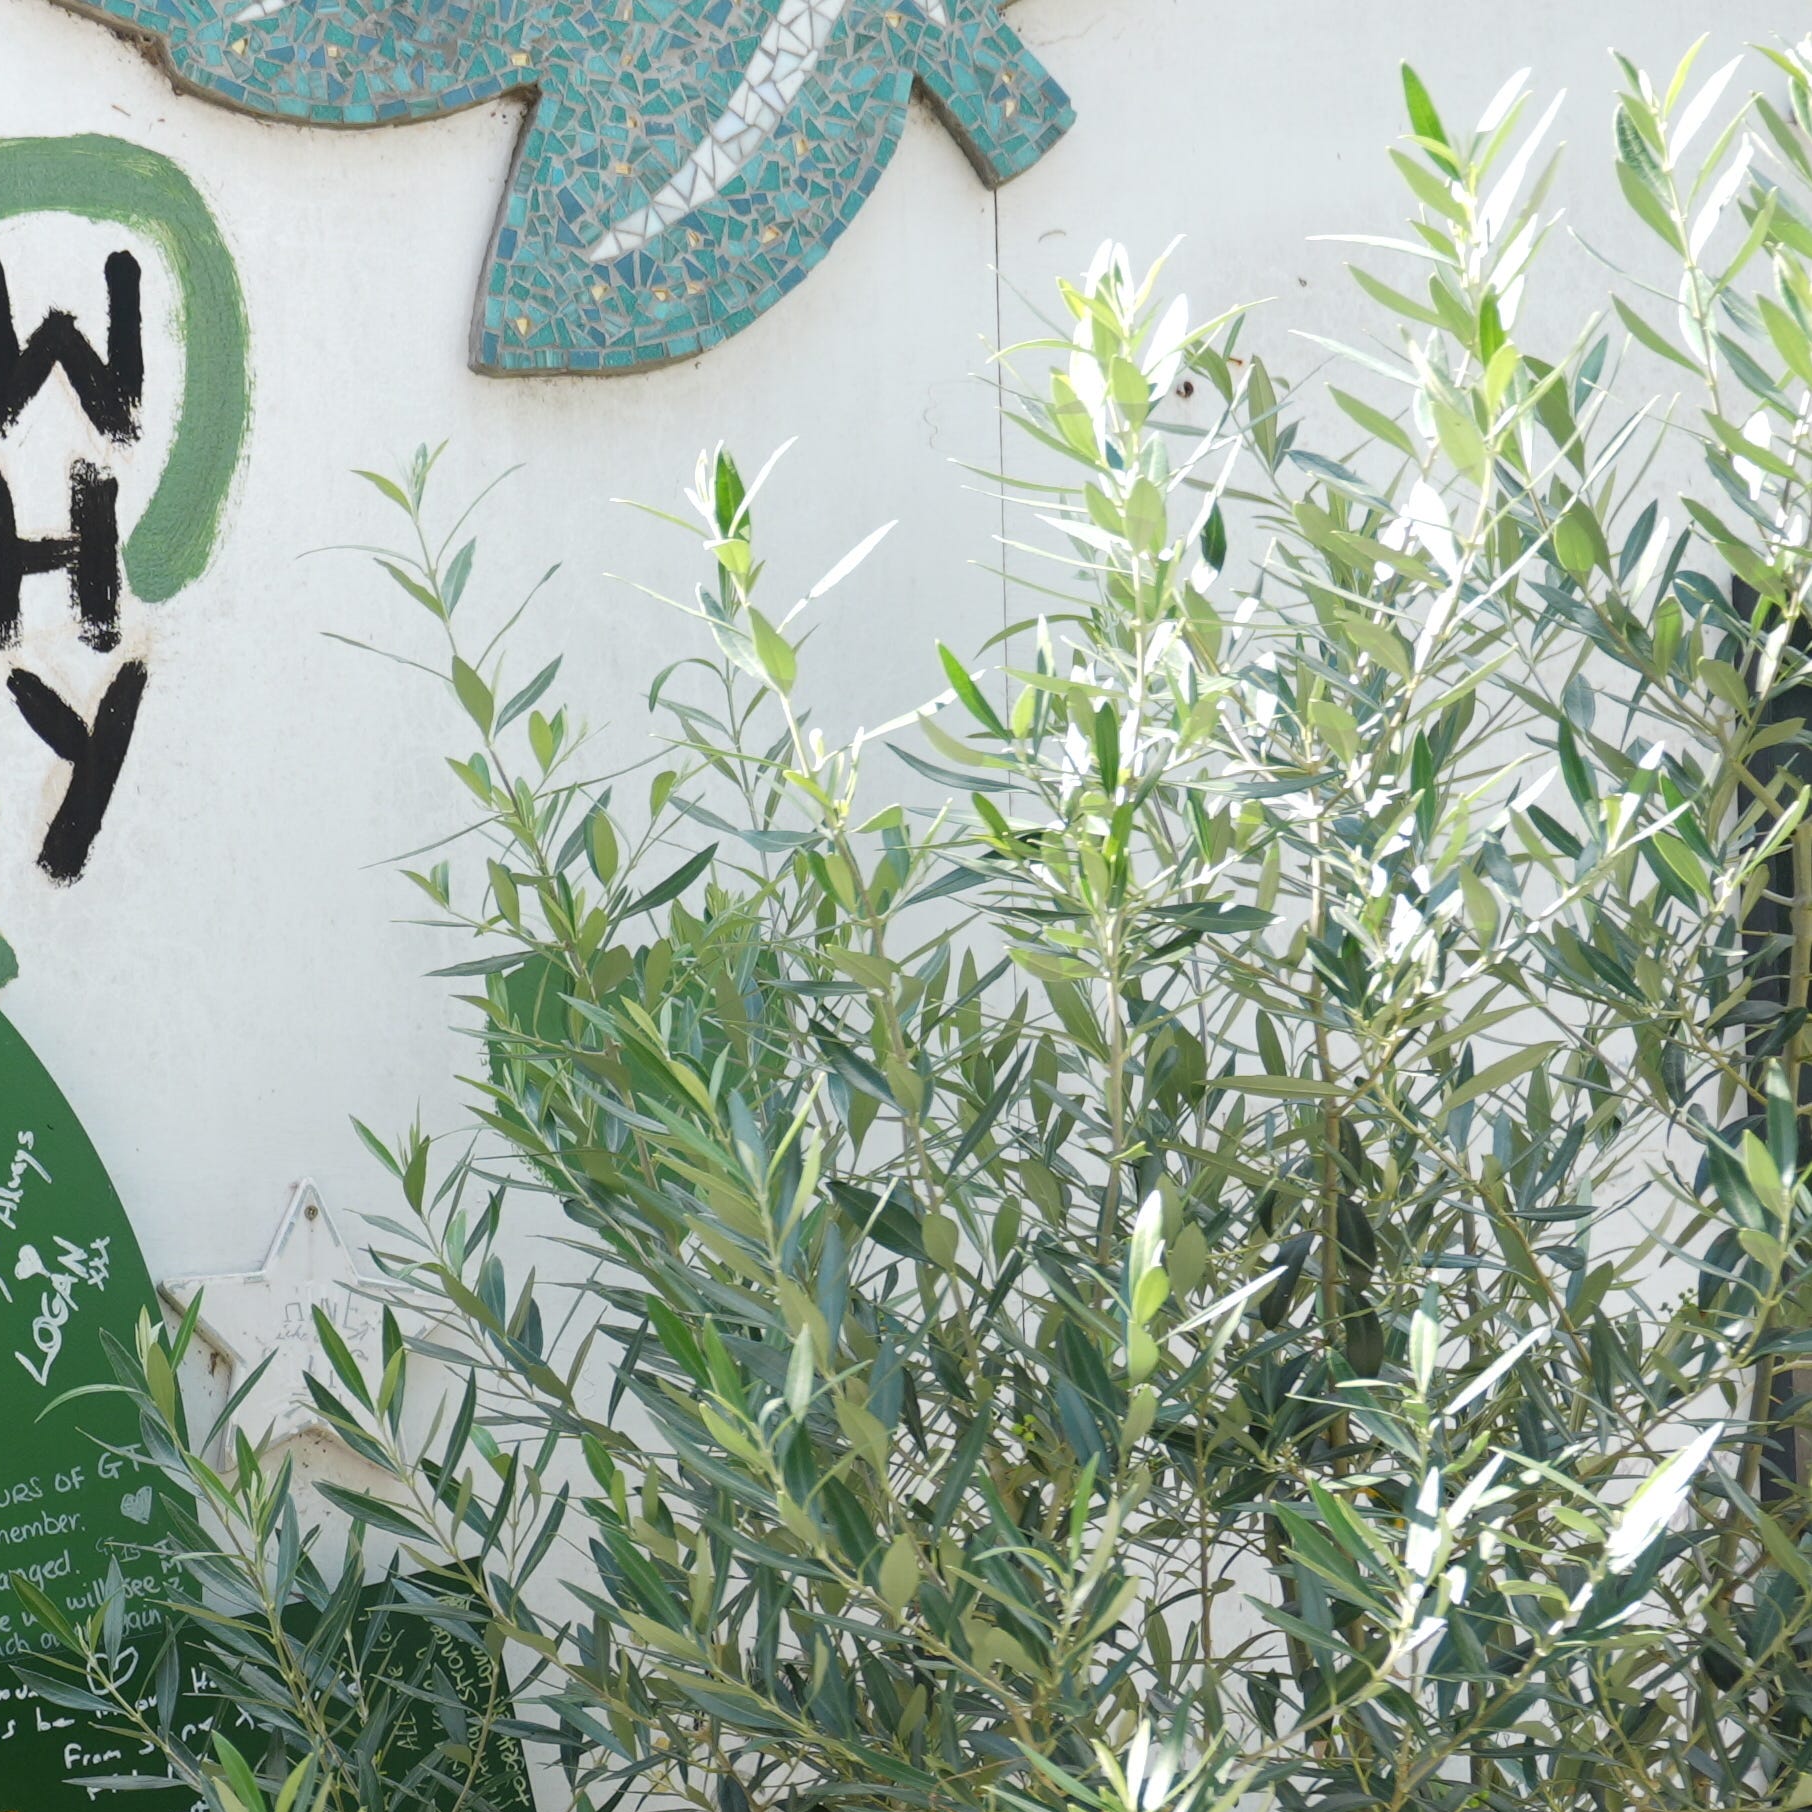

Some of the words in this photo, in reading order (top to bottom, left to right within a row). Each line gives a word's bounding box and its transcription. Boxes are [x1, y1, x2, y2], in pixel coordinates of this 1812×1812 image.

[15, 1235, 88, 1383] LOGAN
[54, 1466, 87, 1496] OF
[98, 1442, 146, 1482] GT
